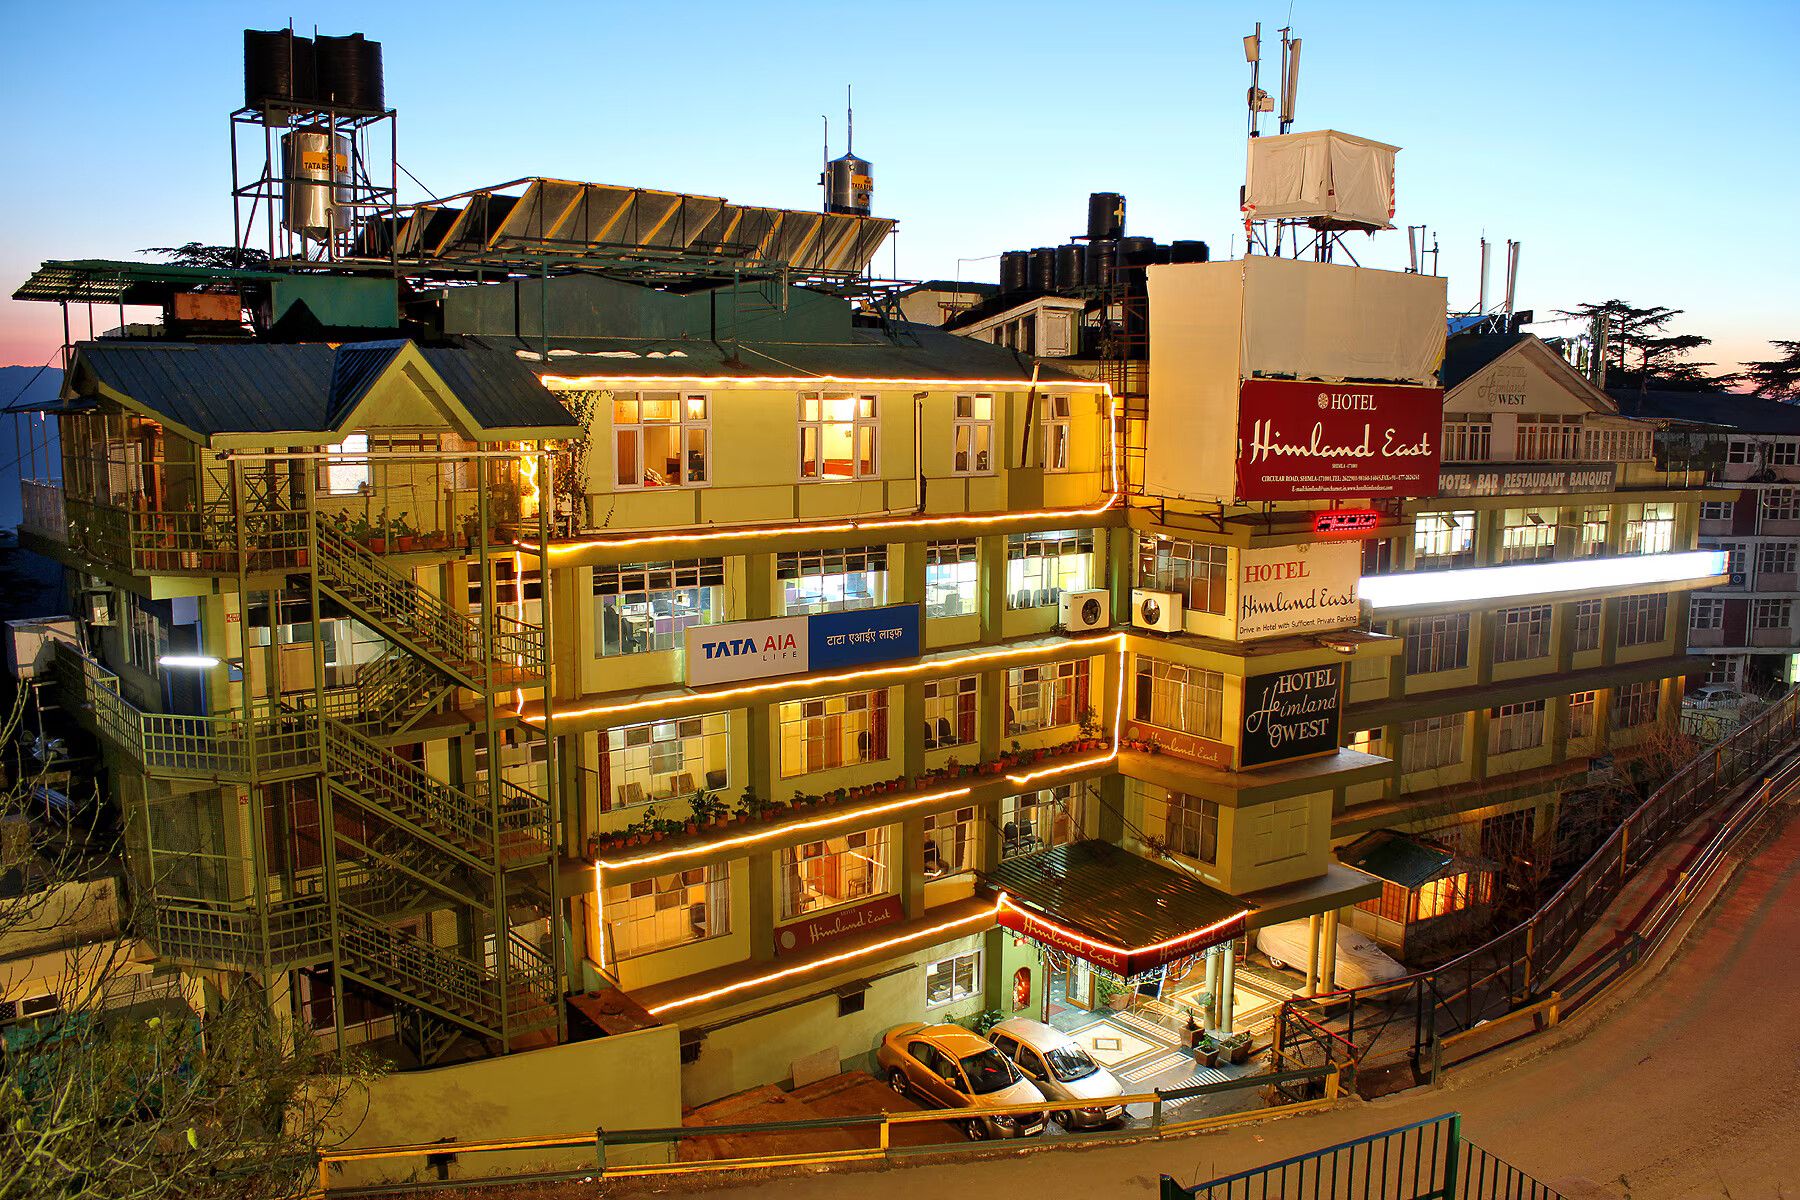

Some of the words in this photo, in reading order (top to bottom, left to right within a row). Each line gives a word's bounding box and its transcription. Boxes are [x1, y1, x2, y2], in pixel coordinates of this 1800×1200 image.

[304, 162, 321, 170] TATA
[1331, 393, 1377, 411] HOTEL
[1498, 394, 1526, 406] WEST
[1250, 418, 1375, 464] Himland
[1381, 427, 1432, 457] East
[1439, 474, 1471, 490] HOTEL
[1477, 473, 1499, 489] BAR
[1503, 472, 1565, 488] RESTAURANT
[1569, 471, 1612, 487] BANQUET
[1244, 561, 1311, 583] HOTEL
[1241, 588, 1316, 622] Himland
[1319, 585, 1355, 607] East
[1239, 626, 1255, 635] Drive
[1262, 623, 1277, 631] Hotel
[1278, 622, 1290, 630] with
[1317, 617, 1335, 625] Private
[1336, 615, 1357, 623] Parking
[702, 638, 758, 659] TATA
[763, 633, 797, 652] AIA
[826, 634, 846, 646] टाटा
[848, 628, 877, 644] एआईए
[763, 651, 797, 662] LIFE
[1278, 669, 1336, 694] HOTEL
[1282, 718, 1329, 742] WEST
[1197, 746, 1218, 762] East
[809, 911, 866, 944] Himland
[867, 908, 891, 924] East
[1023, 915, 1085, 954] Himland
[1089, 946, 1119, 968] East
[1160, 929, 1216, 962] Himland
